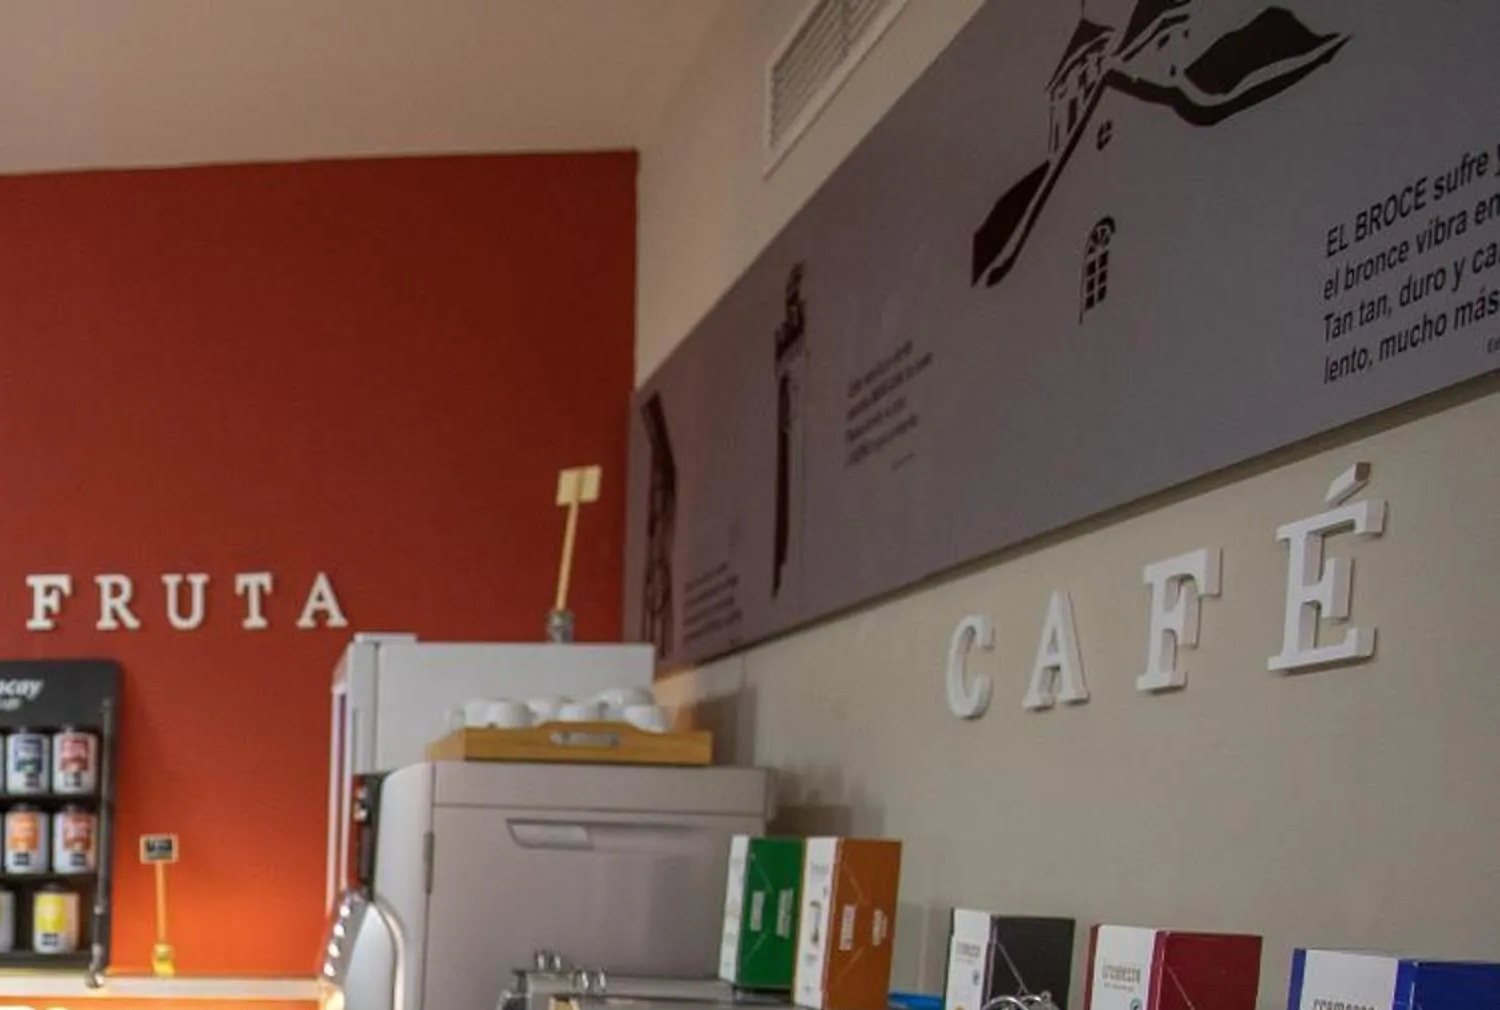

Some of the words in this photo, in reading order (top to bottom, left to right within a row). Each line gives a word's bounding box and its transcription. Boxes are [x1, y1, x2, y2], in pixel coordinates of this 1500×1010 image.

[1326, 223, 1348, 258] EL
[1355, 176, 1428, 243] BROCE
[1434, 150, 1489, 200] sufre
[1323, 268, 1340, 300] el
[1344, 240, 1409, 291] bronce
[1416, 209, 1468, 254] vibra
[1323, 310, 1354, 344] Tan
[1359, 293, 1393, 328] tan,
[1400, 266, 1446, 308] duro
[1452, 255, 1466, 292] y
[1473, 241, 1500, 275] ca
[1323, 347, 1373, 385] lento,
[1379, 311, 1447, 363] mucho
[1453, 287, 1500, 331] más
[25, 571, 348, 630] FRUTA
[946, 461, 1388, 719] CAFÉ
